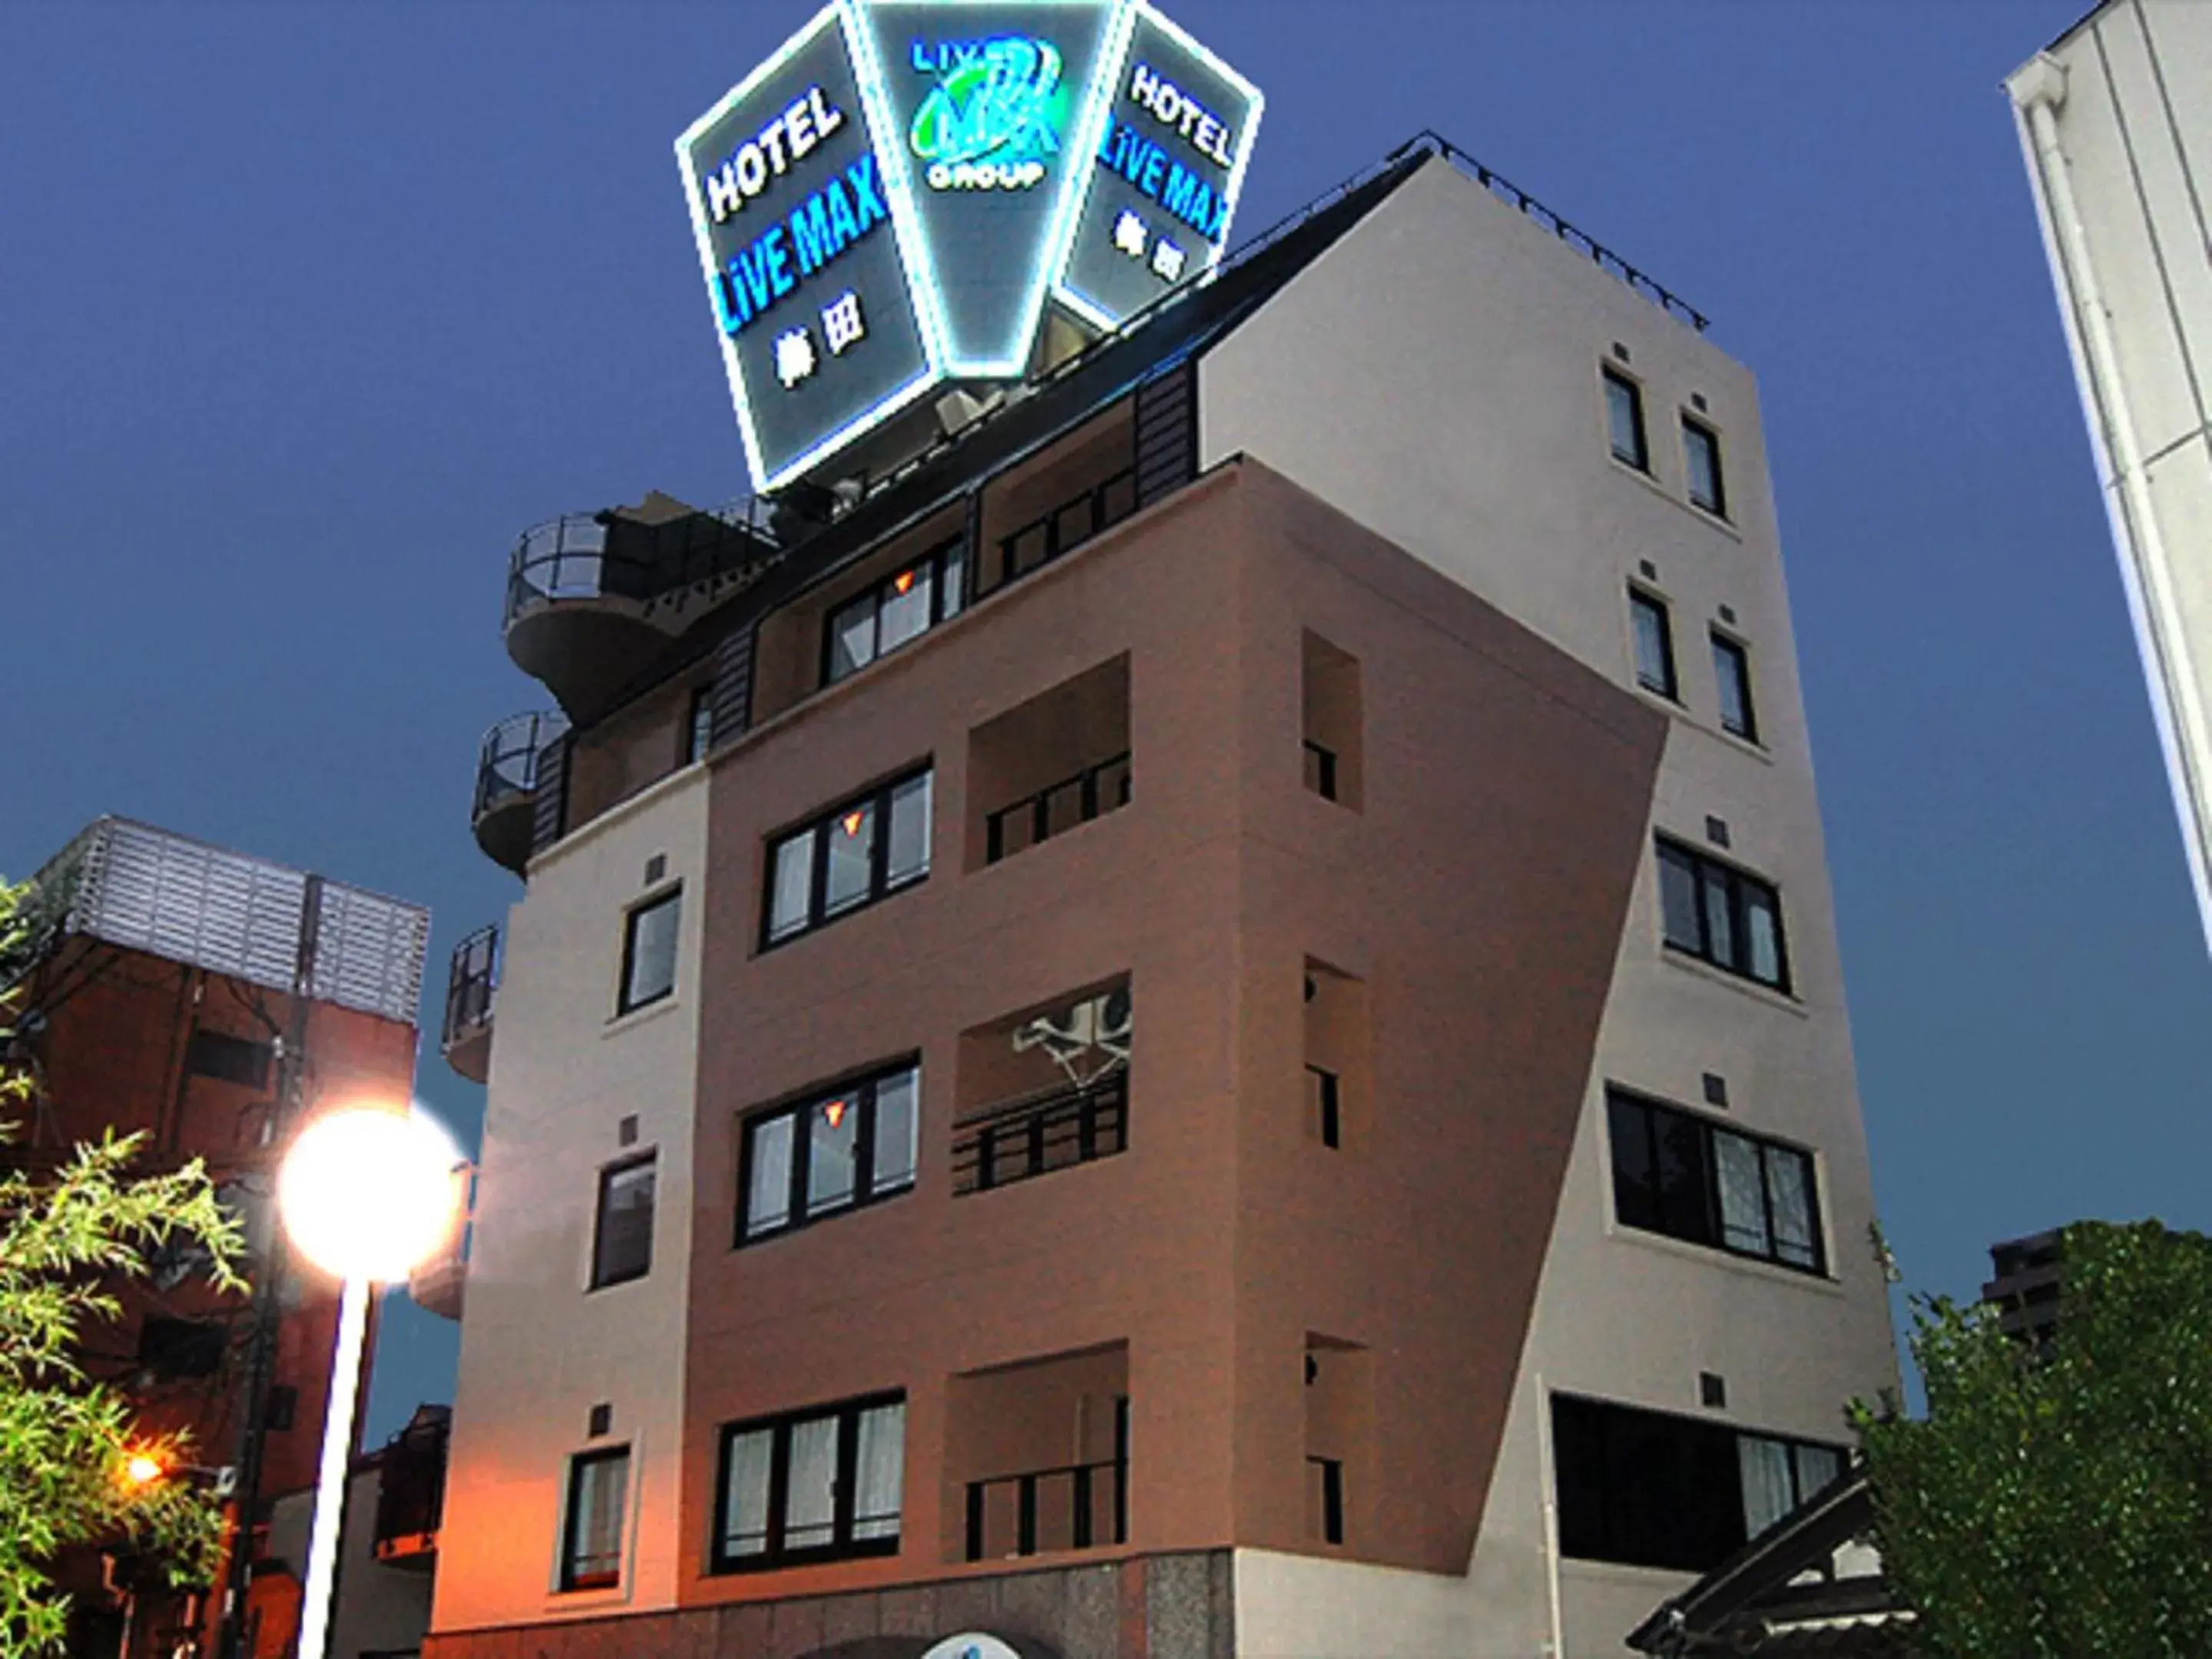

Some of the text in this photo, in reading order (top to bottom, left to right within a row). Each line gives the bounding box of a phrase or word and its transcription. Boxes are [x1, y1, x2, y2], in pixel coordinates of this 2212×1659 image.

[707, 85, 843, 223] HOTEL
[1131, 62, 1233, 168] HOTEL
[789, 154, 888, 275] MAX
[928, 161, 1045, 189] GROUP
